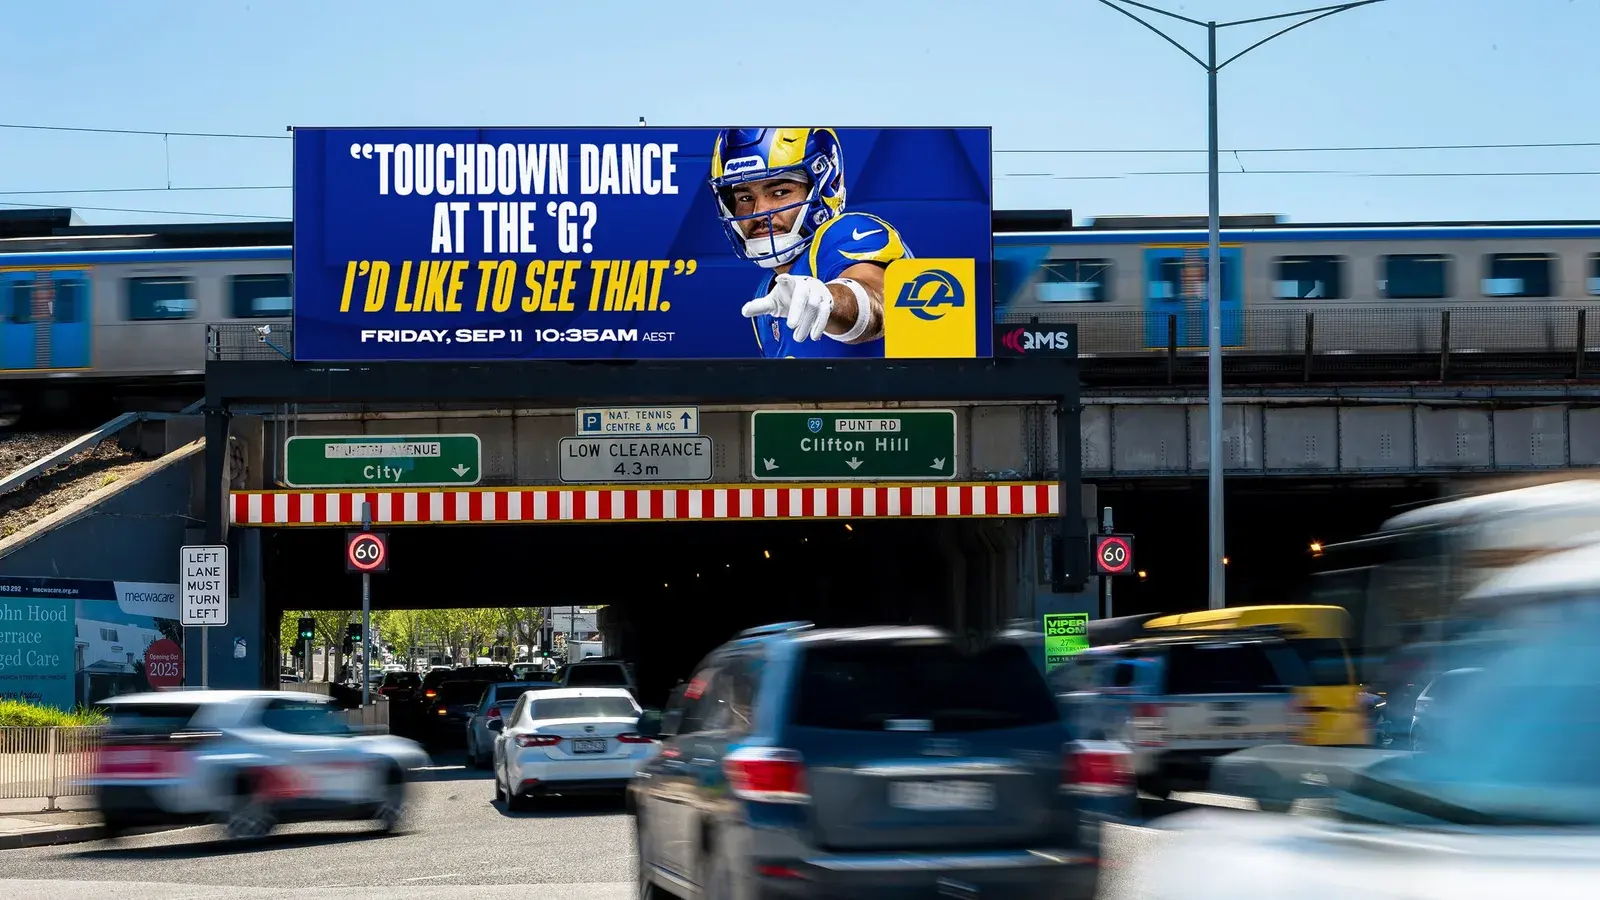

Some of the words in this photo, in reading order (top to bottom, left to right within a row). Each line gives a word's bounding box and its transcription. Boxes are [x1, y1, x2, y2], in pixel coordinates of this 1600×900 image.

[350, 143, 568, 195] “TOUCHDOWN
[580, 143, 679, 195] DANCE
[431, 202, 469, 254] AT
[478, 202, 537, 254] THE
[339, 260, 390, 312] I’D
[394, 260, 464, 312] LIKE
[476, 260, 517, 312] TO
[521, 260, 580, 312] SEE
[361, 329, 451, 345] FRIDAY,
[455, 329, 506, 342] SEP
[510, 329, 523, 342] 11
[535, 329, 638, 342] 10:35AM
[642, 332, 675, 342] AEST
[1014, 329, 1069, 352] QMS
[608, 411, 630, 420] NAT.
[636, 411, 672, 419] TENNIS
[606, 423, 641, 432] CENTRE
[646, 423, 652, 431] &
[657, 422, 676, 431] MCG
[810, 420, 820, 429] 29
[839, 420, 873, 431] PUNT
[880, 420, 897, 430] RD
[569, 444, 600, 457] LOW
[609, 443, 703, 457] CLEARANCE
[801, 438, 865, 451] Clifton
[876, 437, 909, 451] Hill
[363, 465, 402, 482] City
[189, 553, 219, 563] LEFT
[355, 543, 379, 559] 60
[1103, 547, 1125, 562] 60
[187, 567, 220, 577] LANE
[187, 581, 220, 591] MUST
[125, 591, 175, 603] mecwacare
[189, 595, 220, 605] TURN
[28, 605, 67, 622] Hood
[189, 608, 219, 619] LEFT
[1048, 619, 1085, 627] VIPER
[26, 650, 59, 666] Care
[150, 653, 169, 661] Opening
[149, 662, 179, 676] 2025
